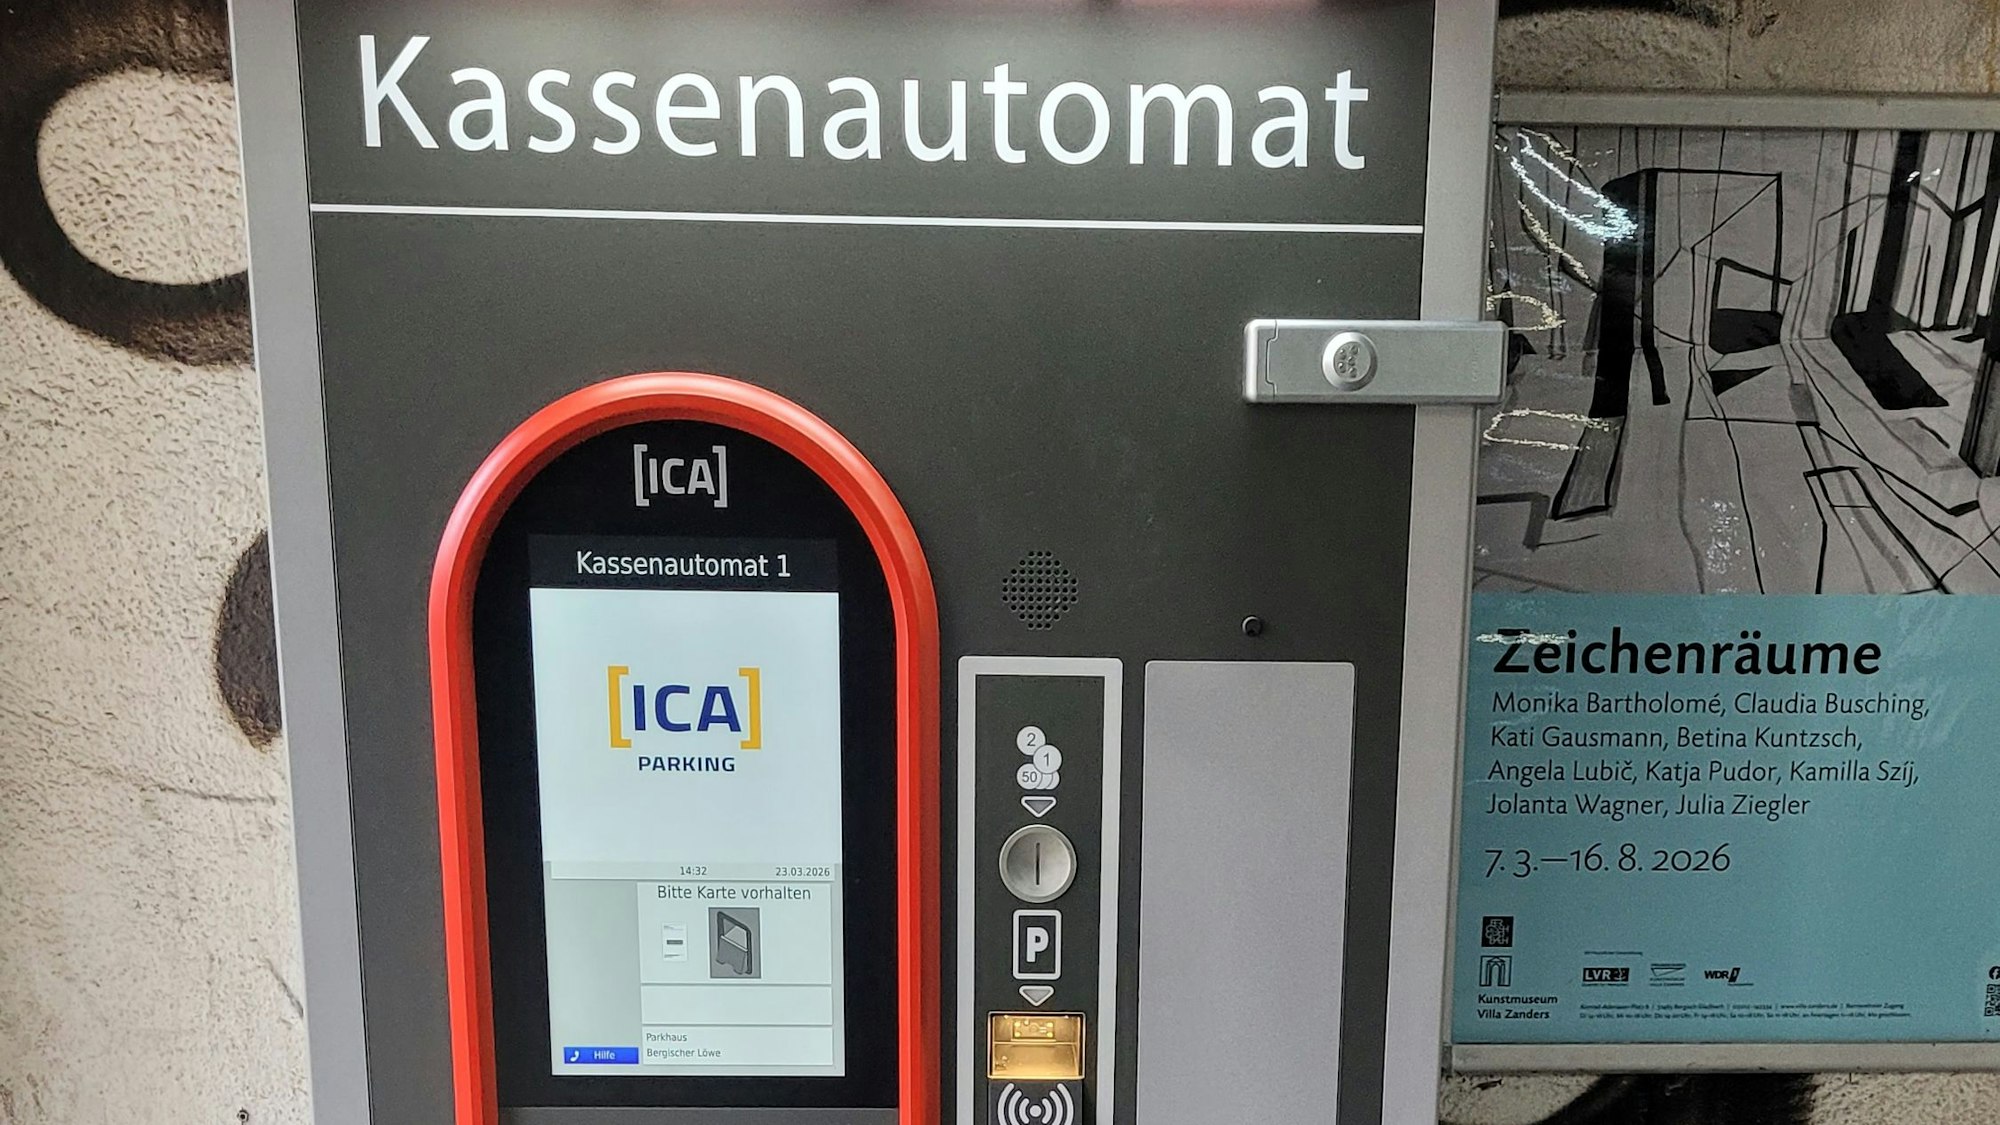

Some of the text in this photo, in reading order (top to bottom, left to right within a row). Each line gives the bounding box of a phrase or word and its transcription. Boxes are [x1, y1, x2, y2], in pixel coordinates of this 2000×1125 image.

[358, 34, 1370, 170] Kassenautomat
[576, 551, 791, 578] Kassenautomat 1
[1493, 626, 1882, 675] Zeichenräume
[1492, 691, 1930, 720] Monika Bartholomé, Claudia Busching,
[1026, 731, 1037, 747] 2
[1491, 725, 1863, 752] Kati Gausmann, Betina Kuntzsch,
[638, 756, 735, 772] PARKING
[1042, 752, 1051, 768] 1
[1021, 770, 1038, 783] 50
[1487, 759, 1920, 787] Angela Lubič, Katja Pudor, Kamilla Szíj,
[1485, 792, 1811, 822] Jolanta Wagner, Julia Ziegler
[1484, 848, 1506, 878] 7.
[1618, 842, 1644, 872] 8.
[1651, 842, 1731, 873] 2026
[680, 866, 707, 876] 14:32
[775, 867, 830, 877] 23.03.2026
[657, 884, 812, 900] Bitte Karte vorhalten
[1026, 926, 1049, 964] P
[1583, 968, 1611, 981] LVR
[1703, 970, 1729, 981] WDR
[1477, 993, 1558, 1005] Kunstmuseum
[1477, 1008, 1550, 1019] Villa Zanders
[646, 1032, 688, 1042] Parkhaus
[593, 1050, 616, 1060] Hilfe
[646, 1048, 721, 1059] Bergischer Löwe
